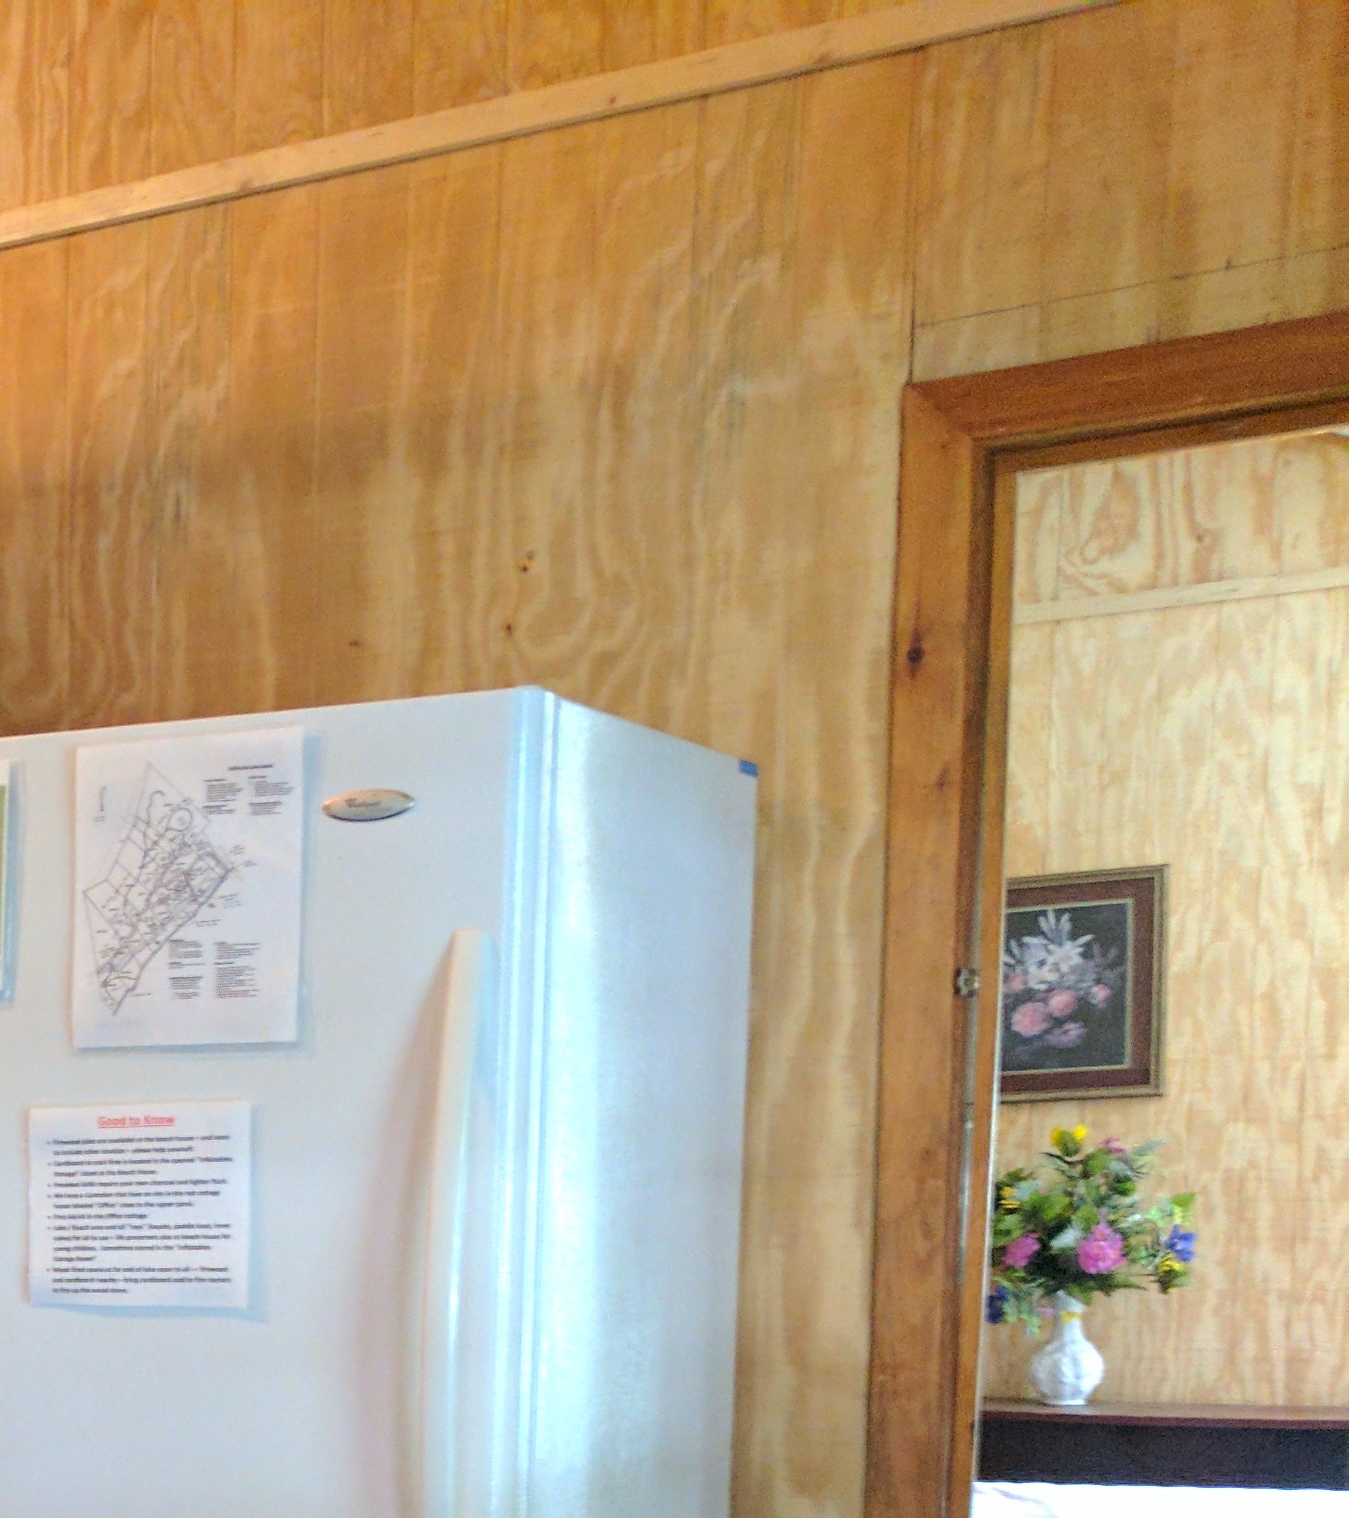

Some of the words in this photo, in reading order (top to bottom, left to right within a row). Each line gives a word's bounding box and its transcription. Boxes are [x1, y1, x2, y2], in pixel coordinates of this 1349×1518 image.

[97, 1116, 126, 1128] Good
[129, 1116, 140, 1126] to
[143, 1115, 176, 1126] Know
